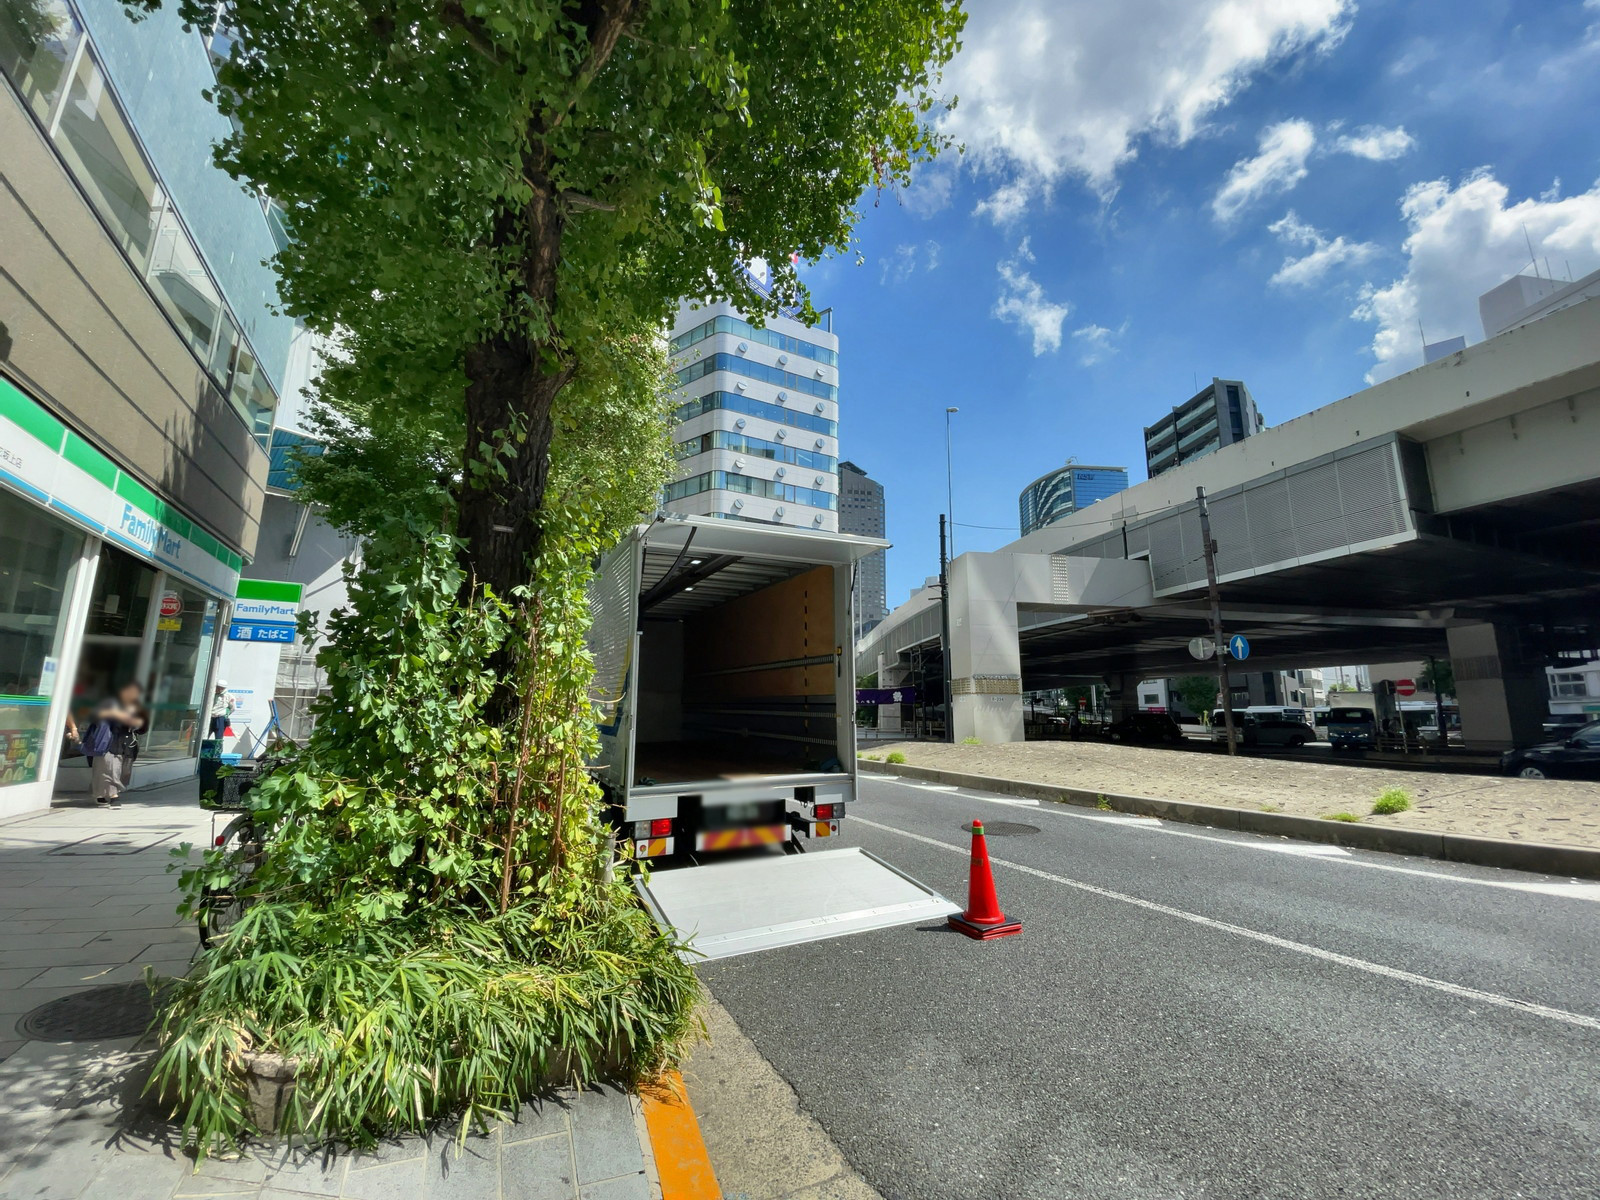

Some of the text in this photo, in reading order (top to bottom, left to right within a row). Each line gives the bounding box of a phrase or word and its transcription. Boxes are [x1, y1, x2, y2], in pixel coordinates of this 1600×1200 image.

[120, 503, 181, 559] FamilyMart
[236, 603, 295, 615] FamilyMart
[236, 626, 289, 640] 酒 たばこ
